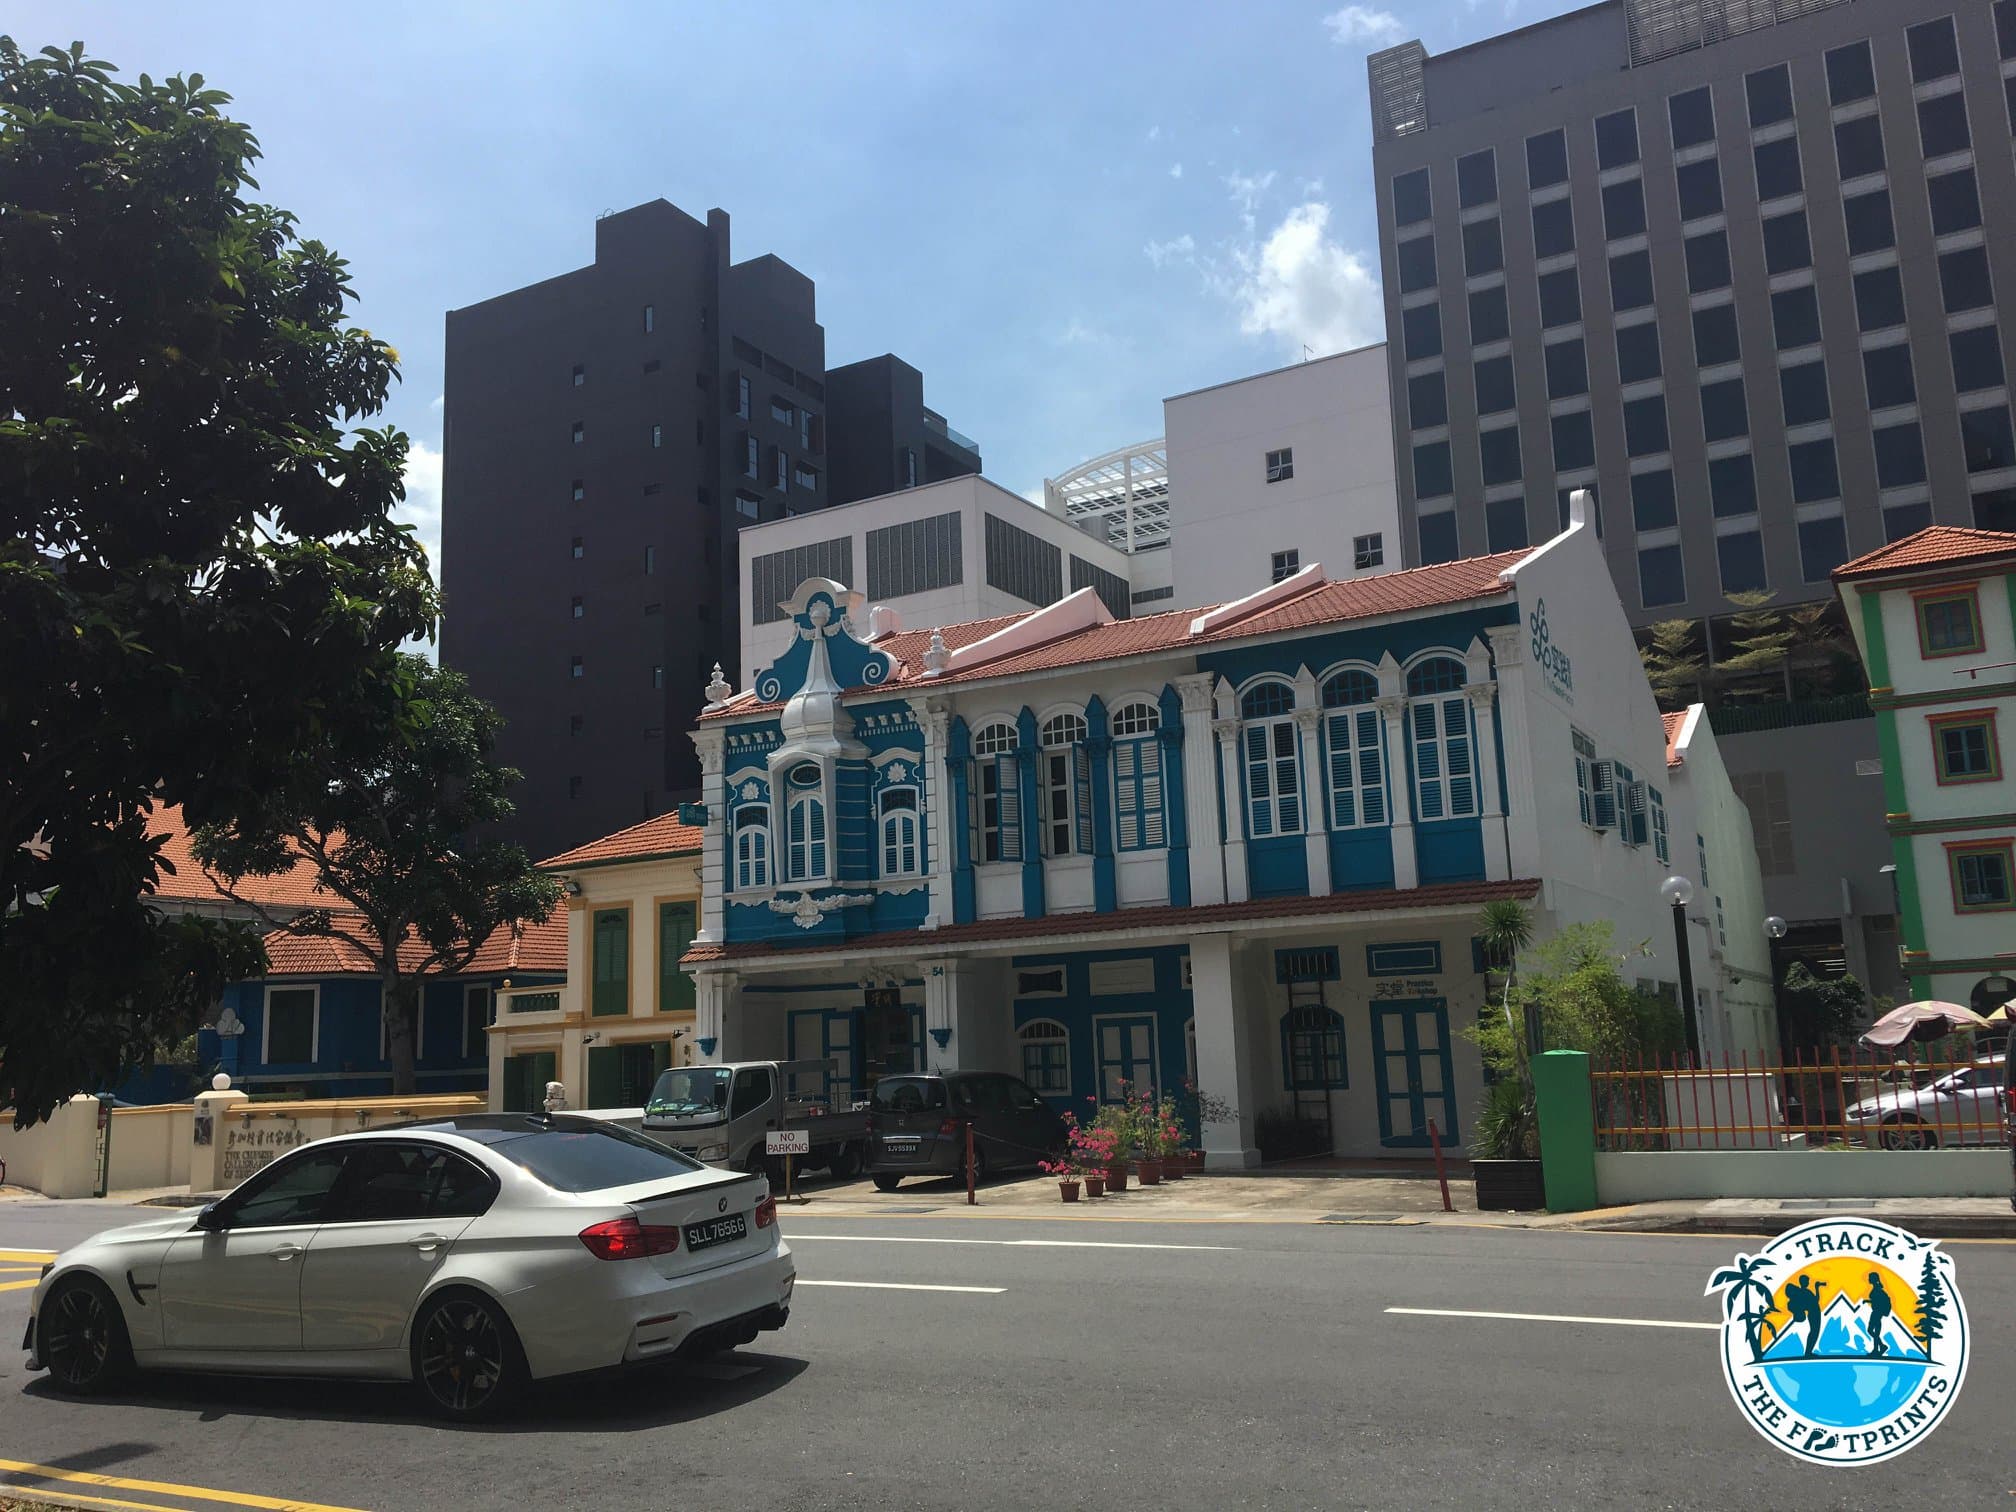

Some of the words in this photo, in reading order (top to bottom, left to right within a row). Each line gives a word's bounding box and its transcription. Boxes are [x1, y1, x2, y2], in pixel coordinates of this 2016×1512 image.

[932, 966, 944, 976] 54
[780, 1132, 795, 1142] NO
[767, 1143, 808, 1152] PARKING
[225, 1151, 240, 1160] THE
[689, 1217, 745, 1244] SLL7656G
